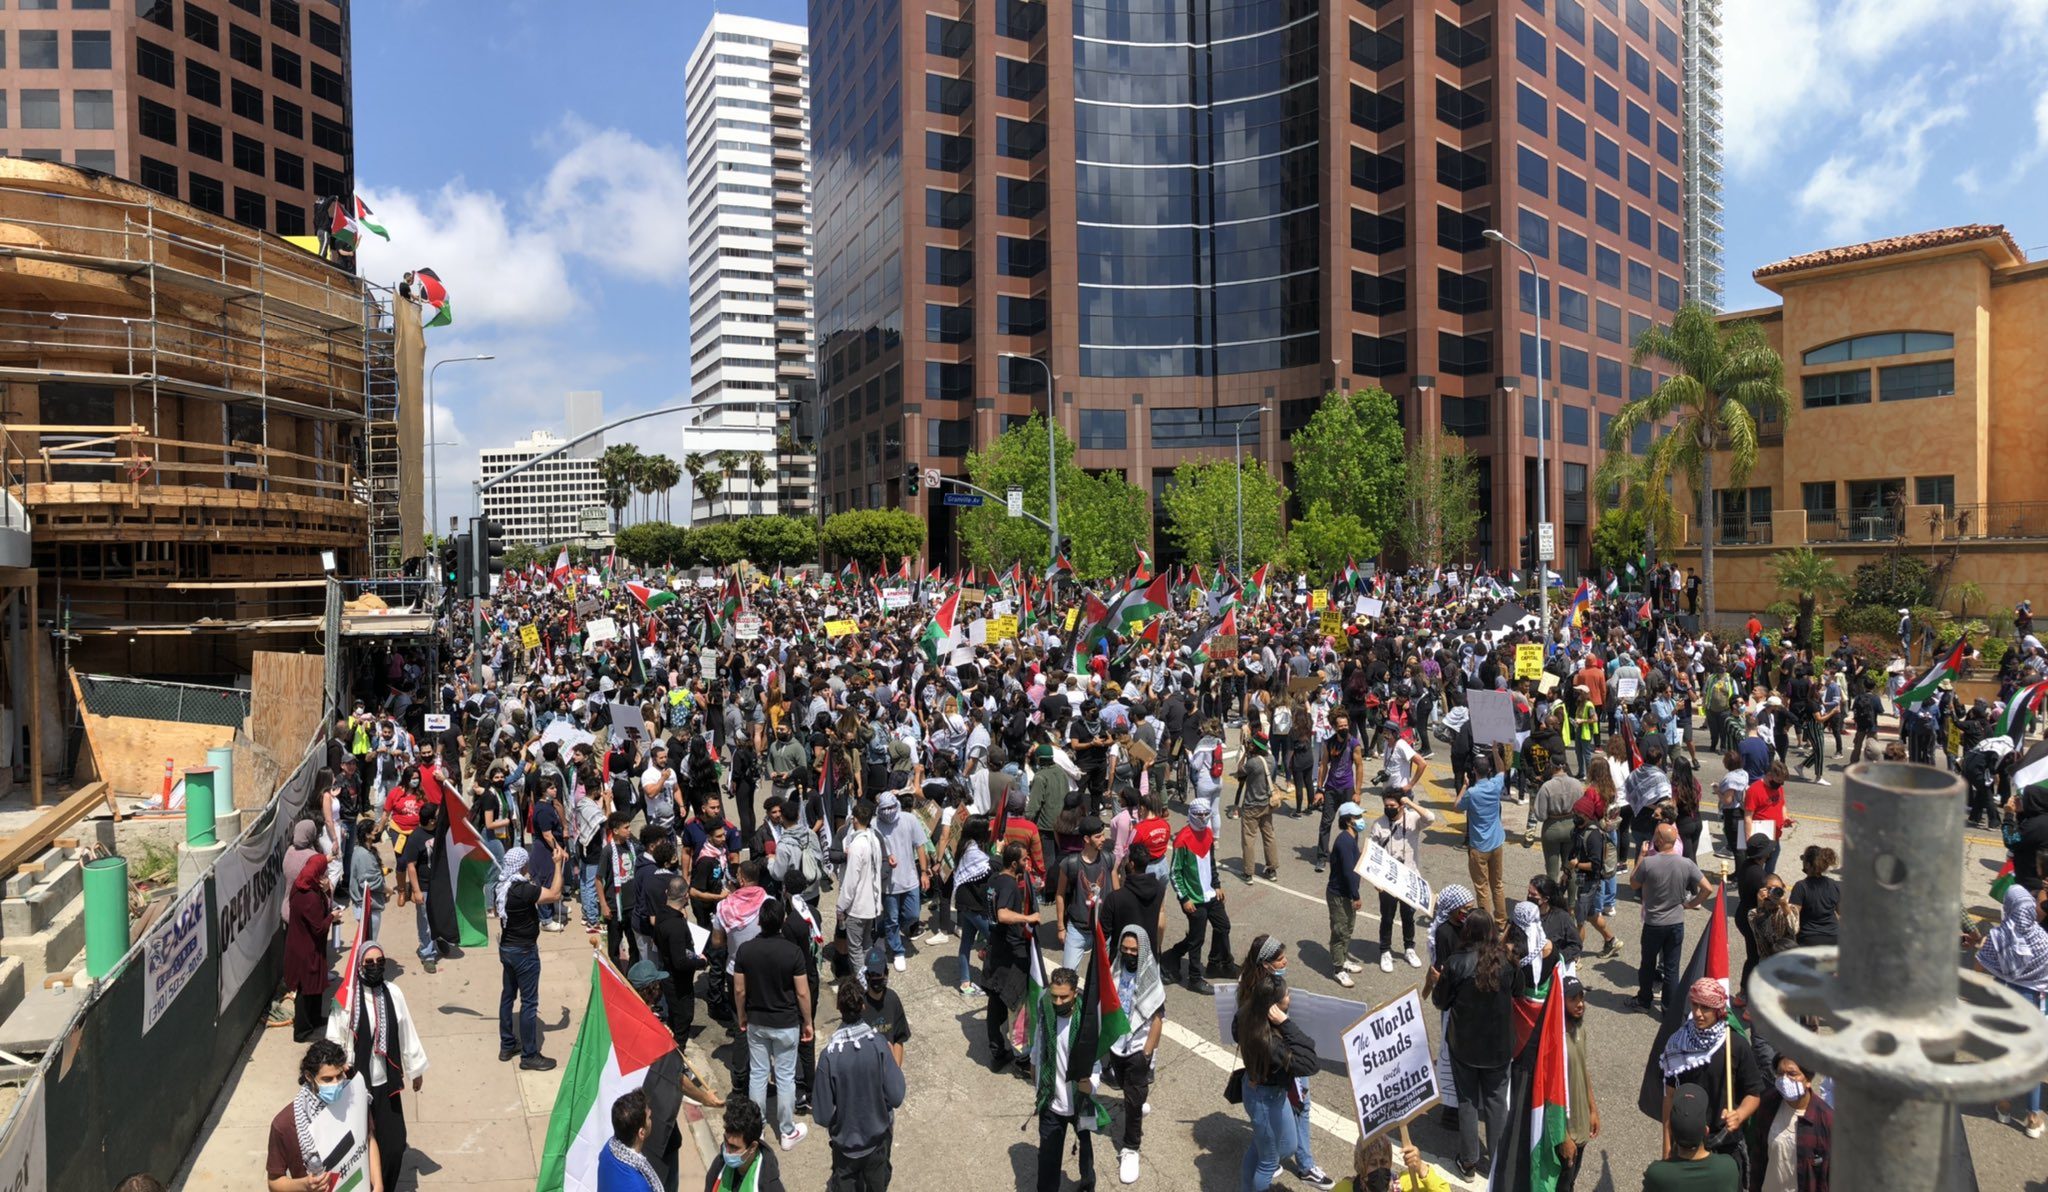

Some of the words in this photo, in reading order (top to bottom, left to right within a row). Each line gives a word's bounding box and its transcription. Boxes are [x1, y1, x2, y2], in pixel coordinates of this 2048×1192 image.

[221, 879, 251, 953] OPEN
[148, 990, 168, 1026] (310)
[1352, 1032, 1370, 1057] The
[1370, 1000, 1415, 1041] World
[1362, 1032, 1412, 1076] Stands
[1383, 1063, 1401, 1082] with
[1360, 1065, 1430, 1115] Palestine
[1368, 1103, 1388, 1123] Party
[1395, 1084, 1427, 1108] Socialism
[1386, 1098, 1421, 1120] Liberation
